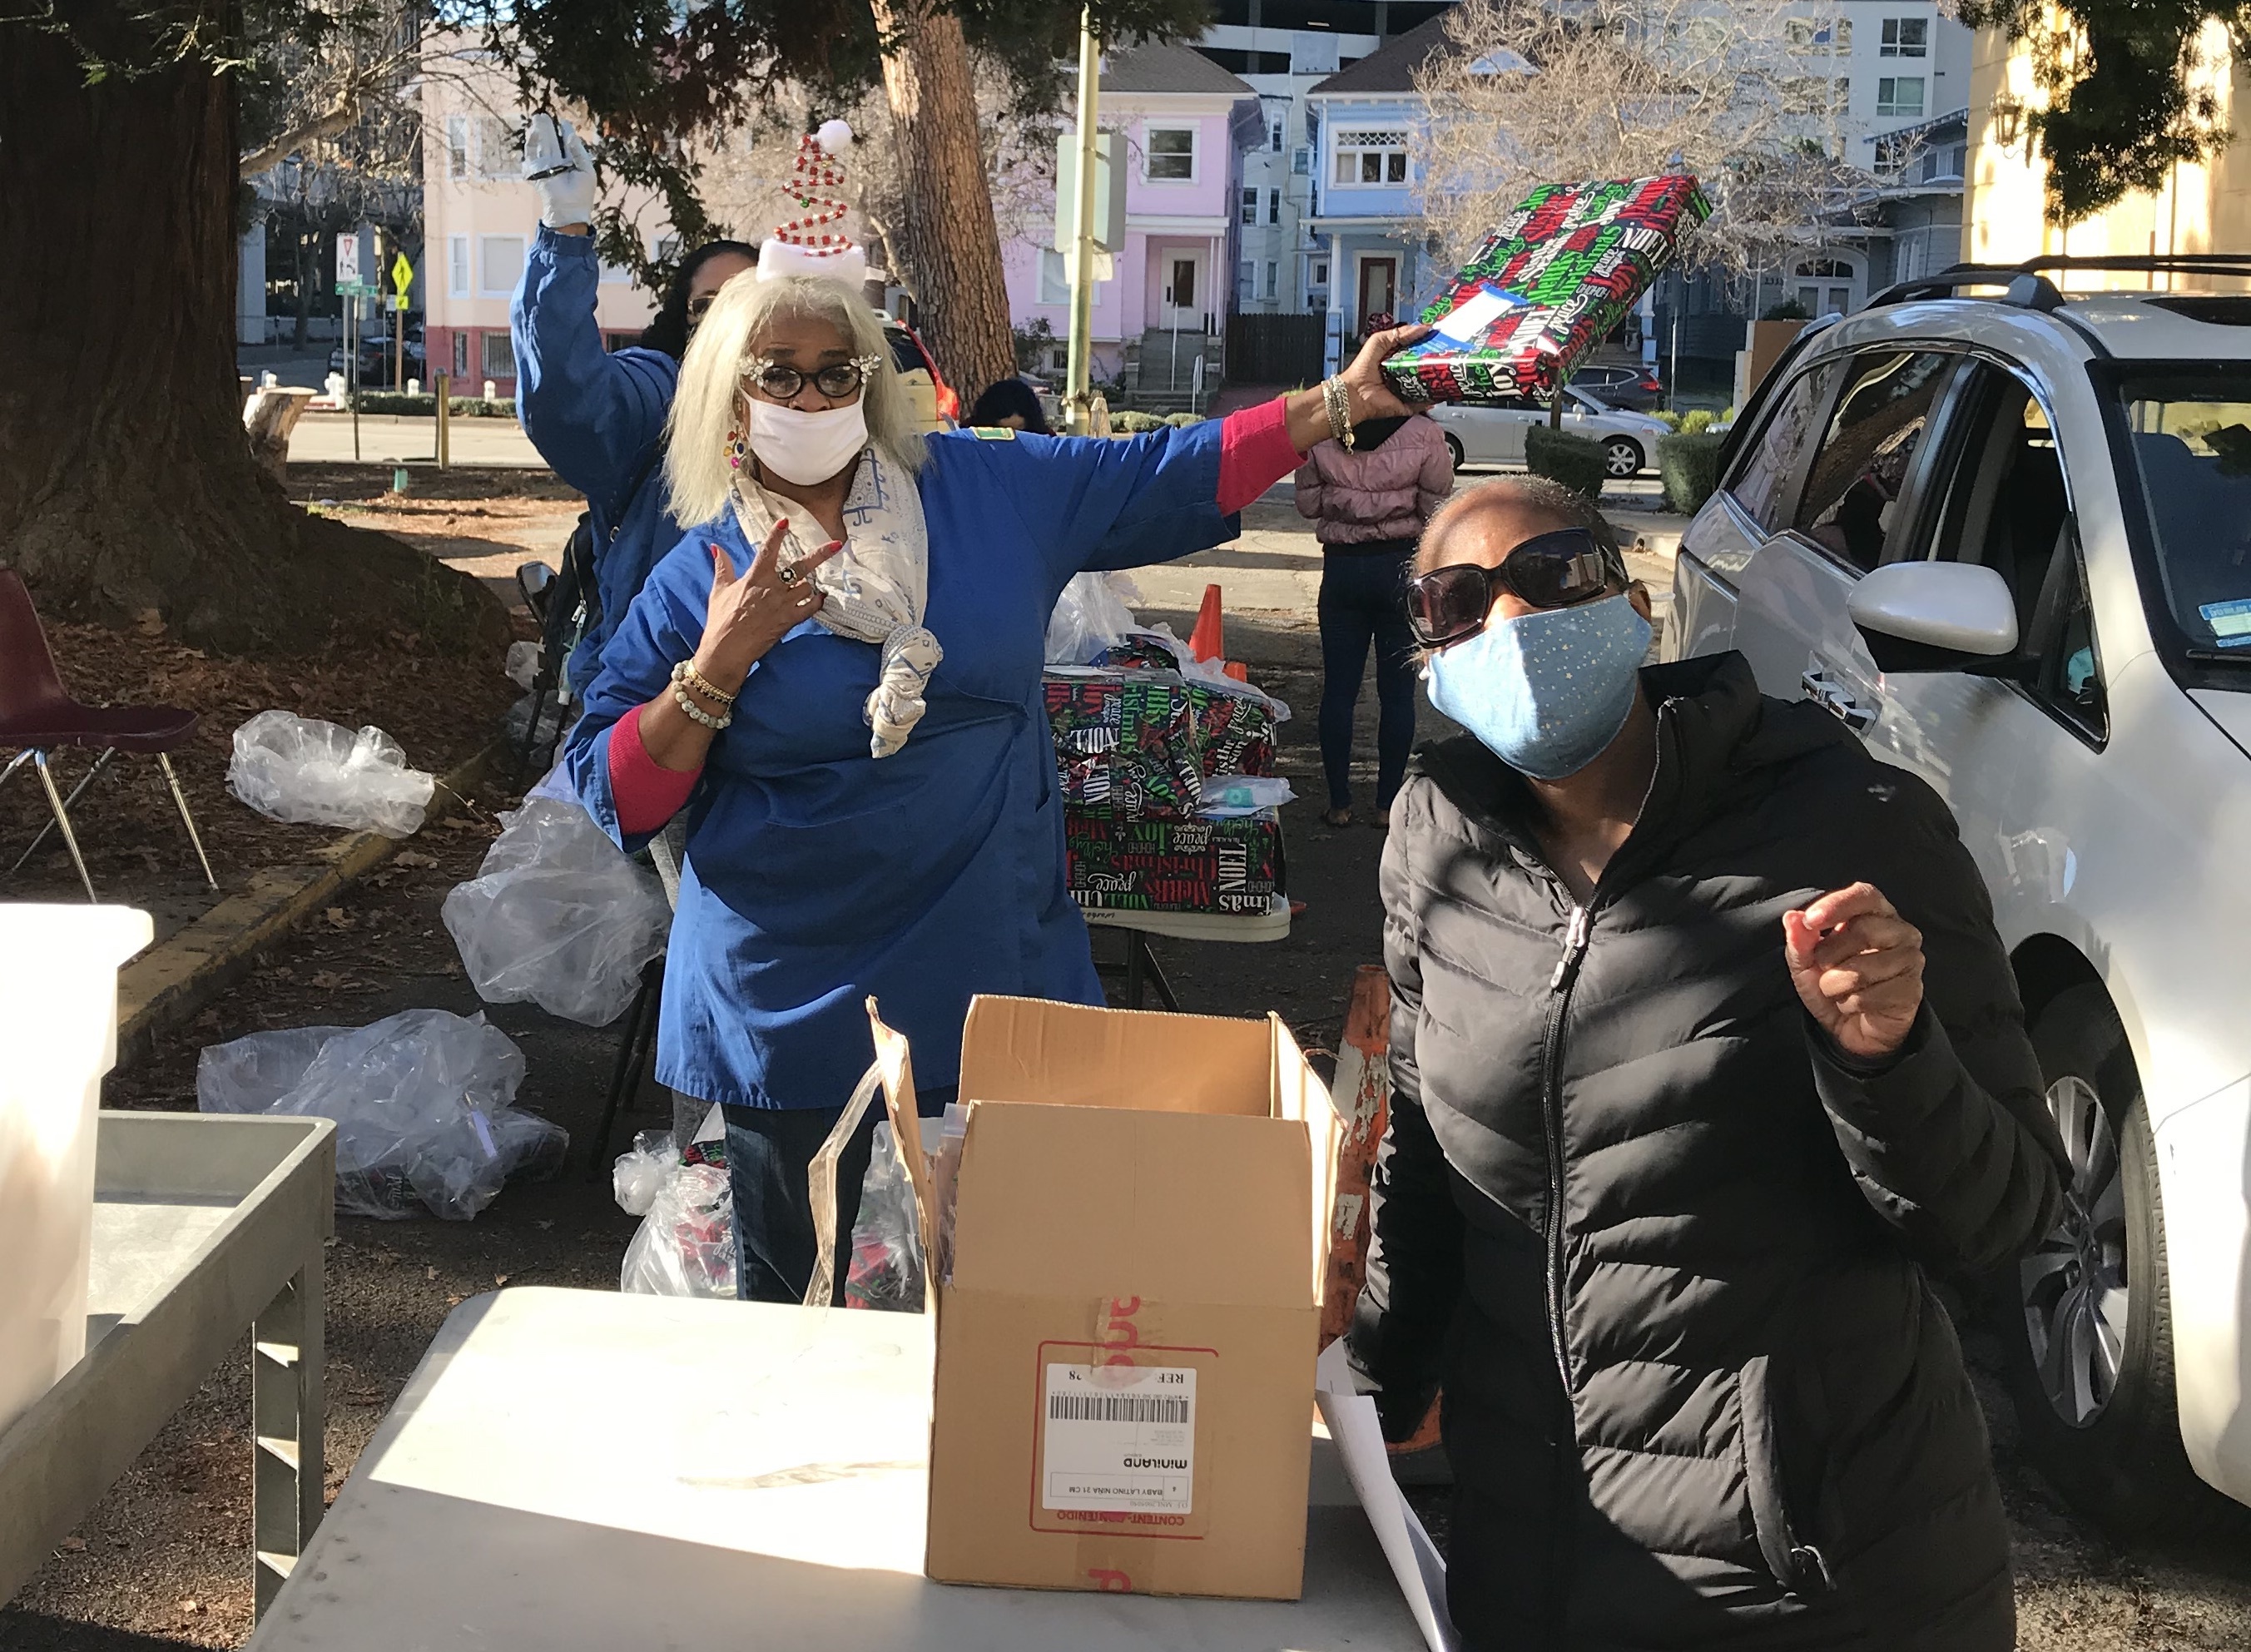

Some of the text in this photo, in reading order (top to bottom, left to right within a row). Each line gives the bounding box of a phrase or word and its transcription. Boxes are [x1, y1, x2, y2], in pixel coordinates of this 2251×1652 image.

[1540, 225, 1624, 305] Christmas
[1611, 227, 1671, 270] NOEL
[1546, 294, 1583, 334] peace
[1486, 360, 1525, 398] joy
[1173, 825, 1213, 846] peace
[1087, 871, 1137, 892] peace
[1218, 843, 1247, 893] NOEL
[1218, 894, 1273, 916] tmas
